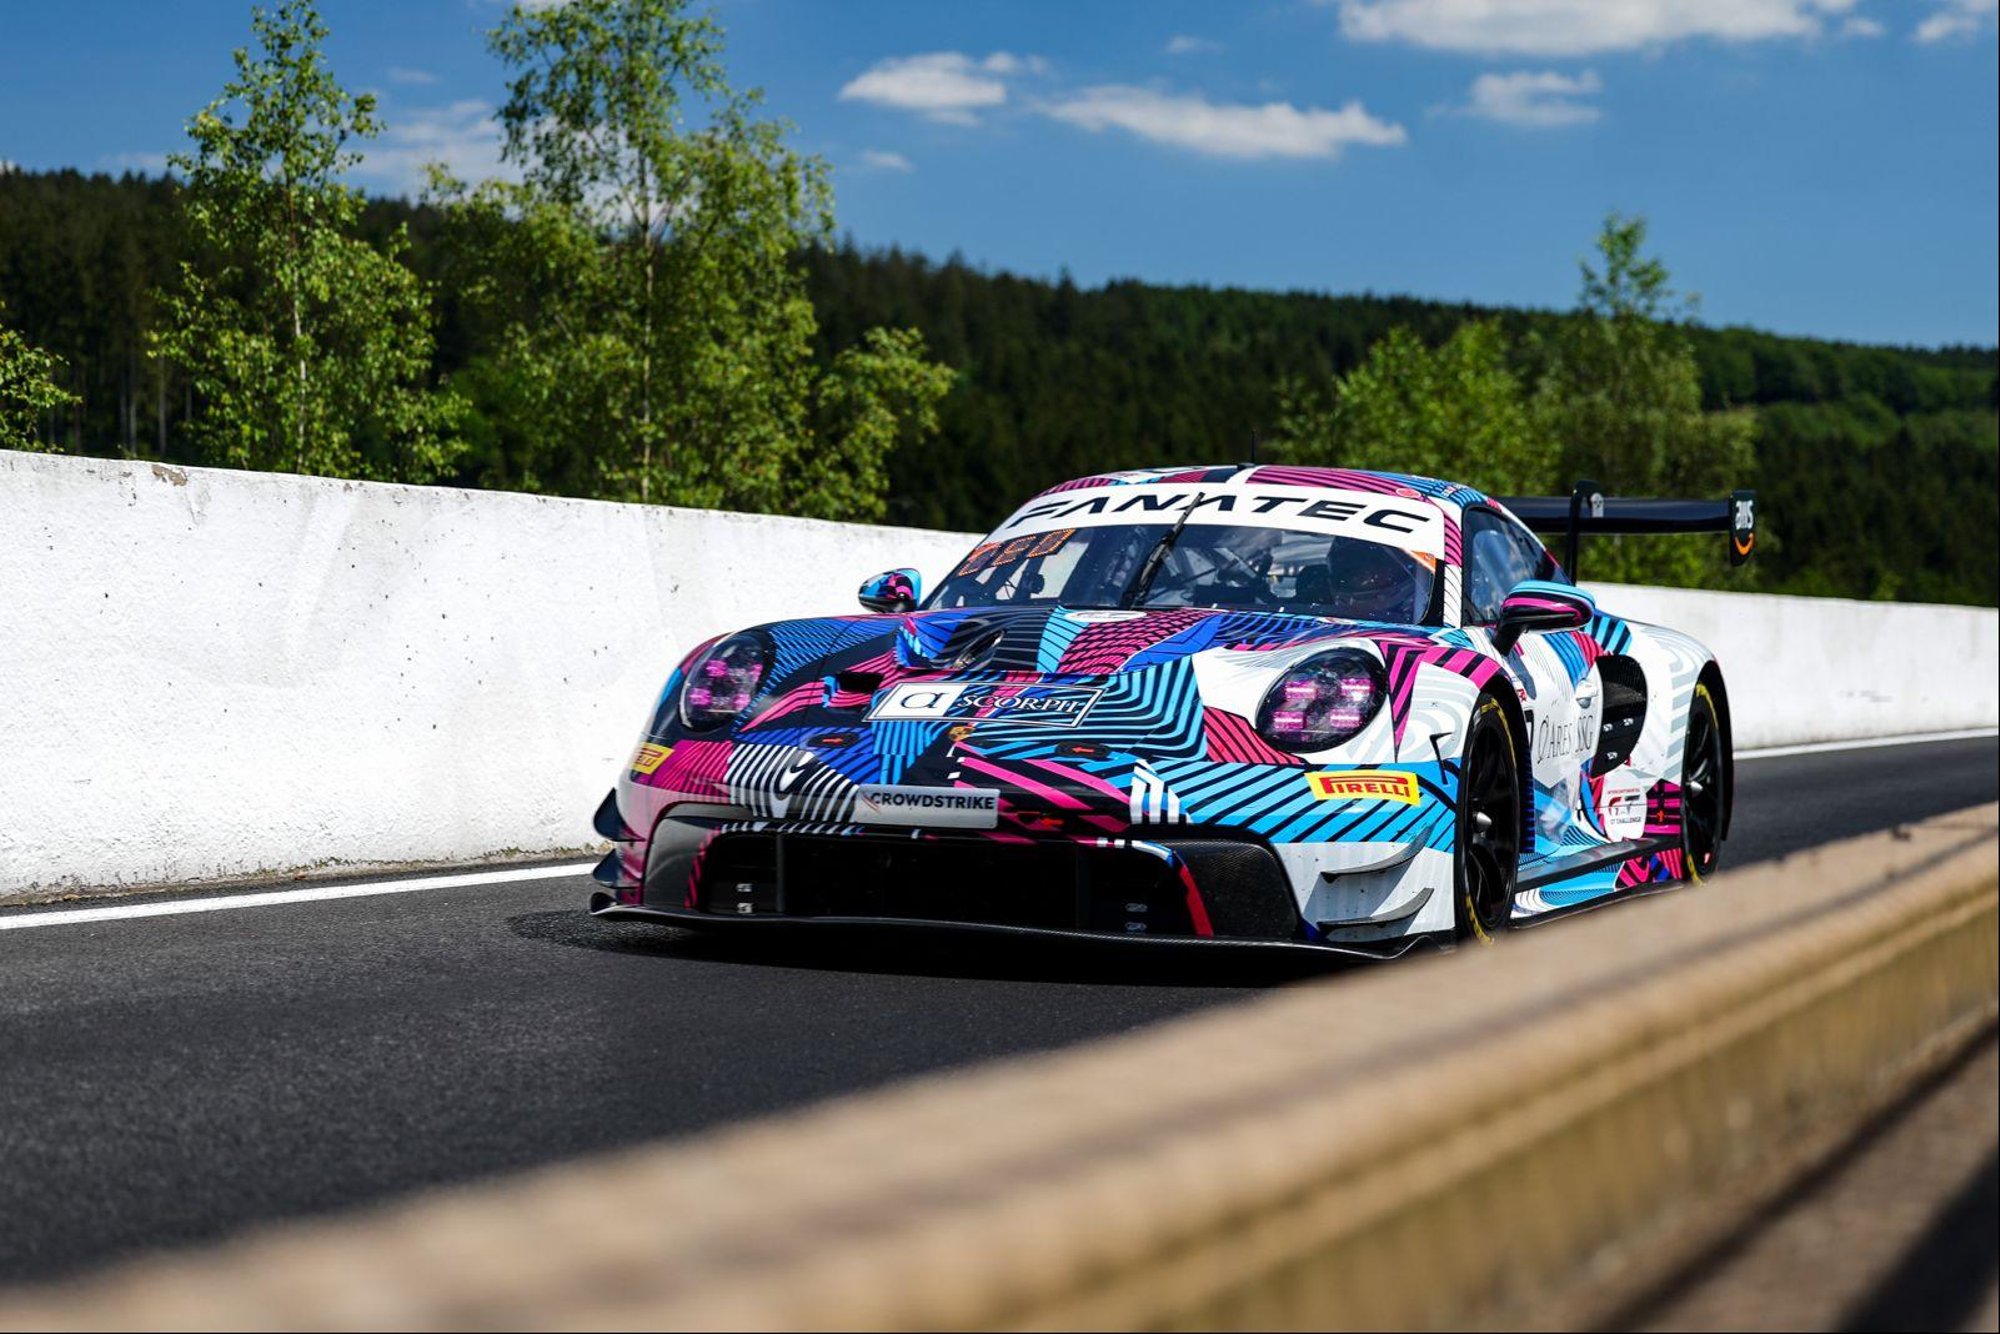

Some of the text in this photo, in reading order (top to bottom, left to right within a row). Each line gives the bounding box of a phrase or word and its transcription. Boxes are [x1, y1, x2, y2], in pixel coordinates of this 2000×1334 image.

[1006, 493, 1431, 534] FANATEC
[1319, 775, 1411, 797] PIRELLI
[870, 792, 995, 810] CROWDSTRIKE
